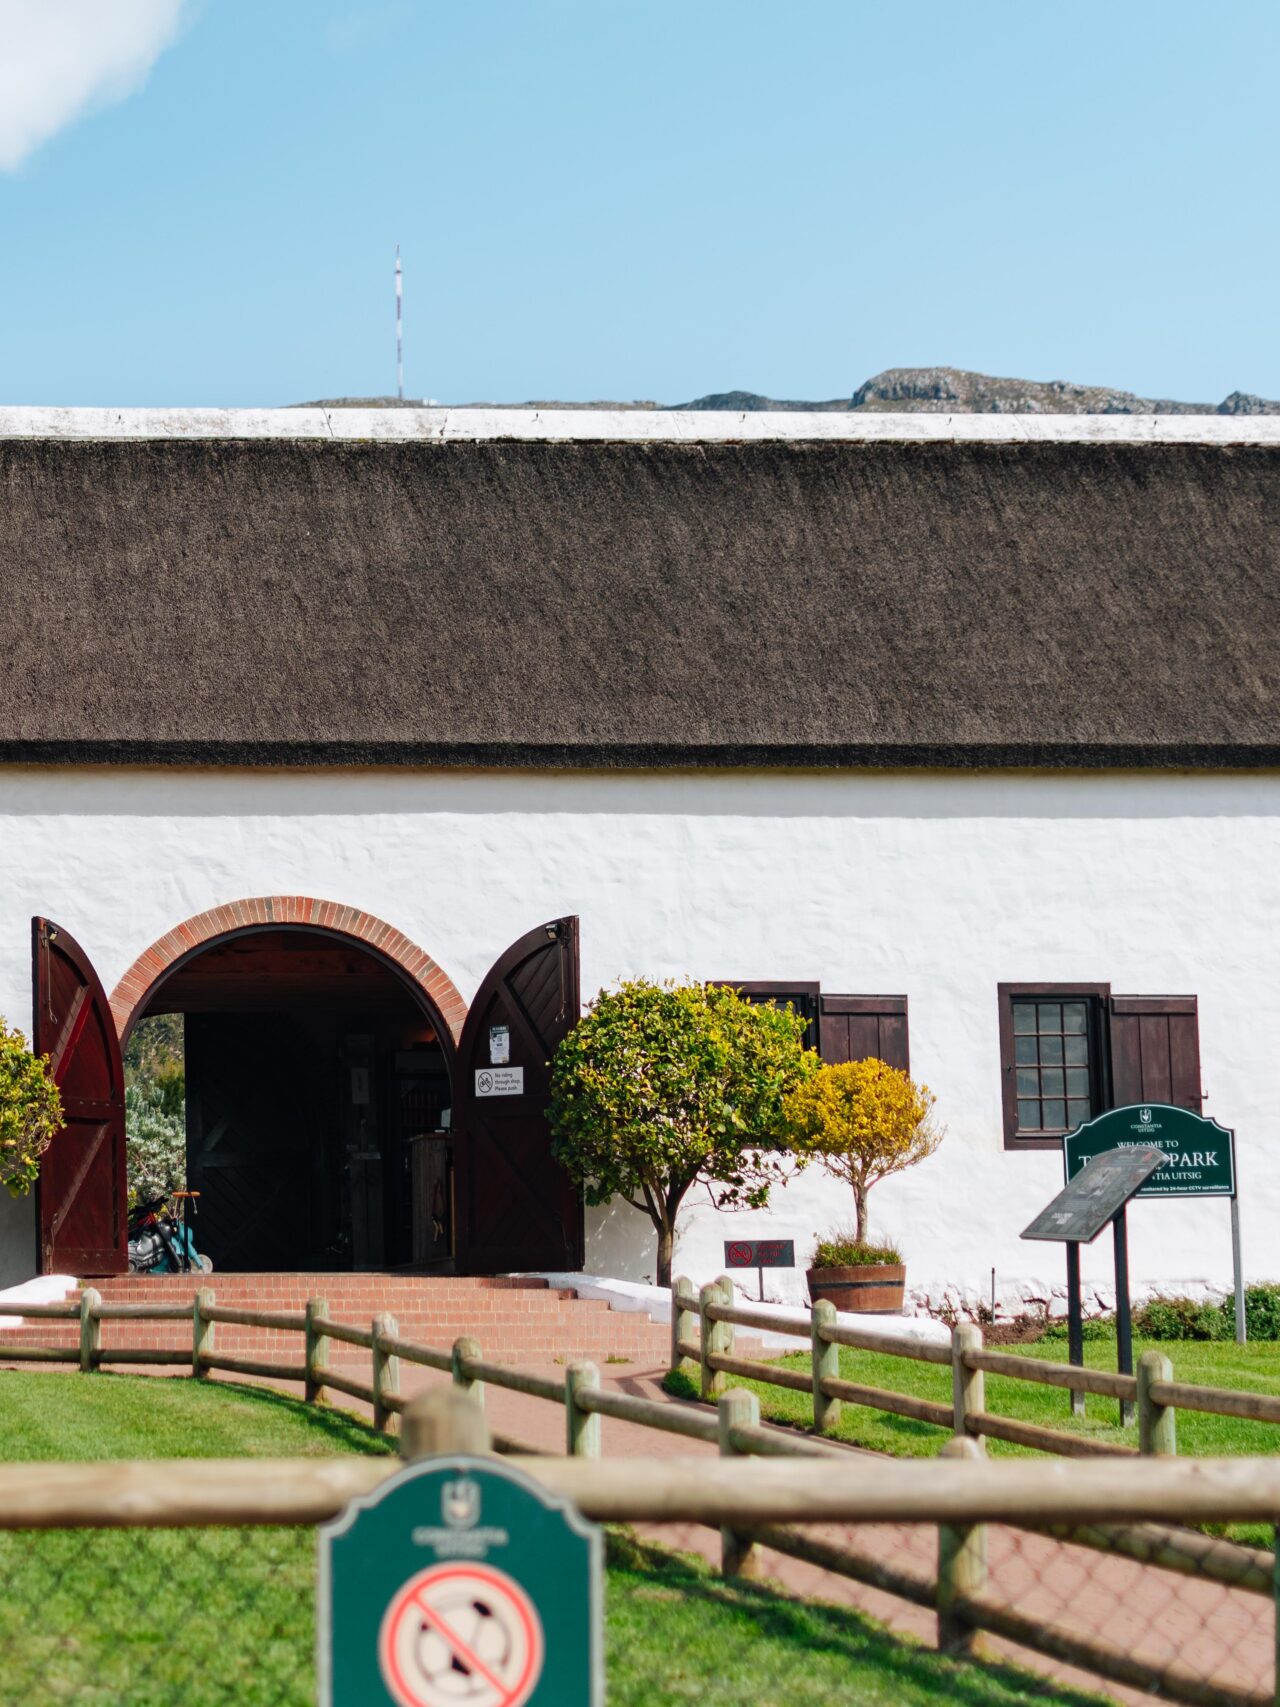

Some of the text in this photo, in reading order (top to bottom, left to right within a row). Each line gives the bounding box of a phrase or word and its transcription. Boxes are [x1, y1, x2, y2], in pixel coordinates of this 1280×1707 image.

[1117, 1140, 1179, 1148] WELCOME TO
[1169, 1152, 1219, 1168] PARK
[1172, 1171, 1202, 1180] UITSIG
